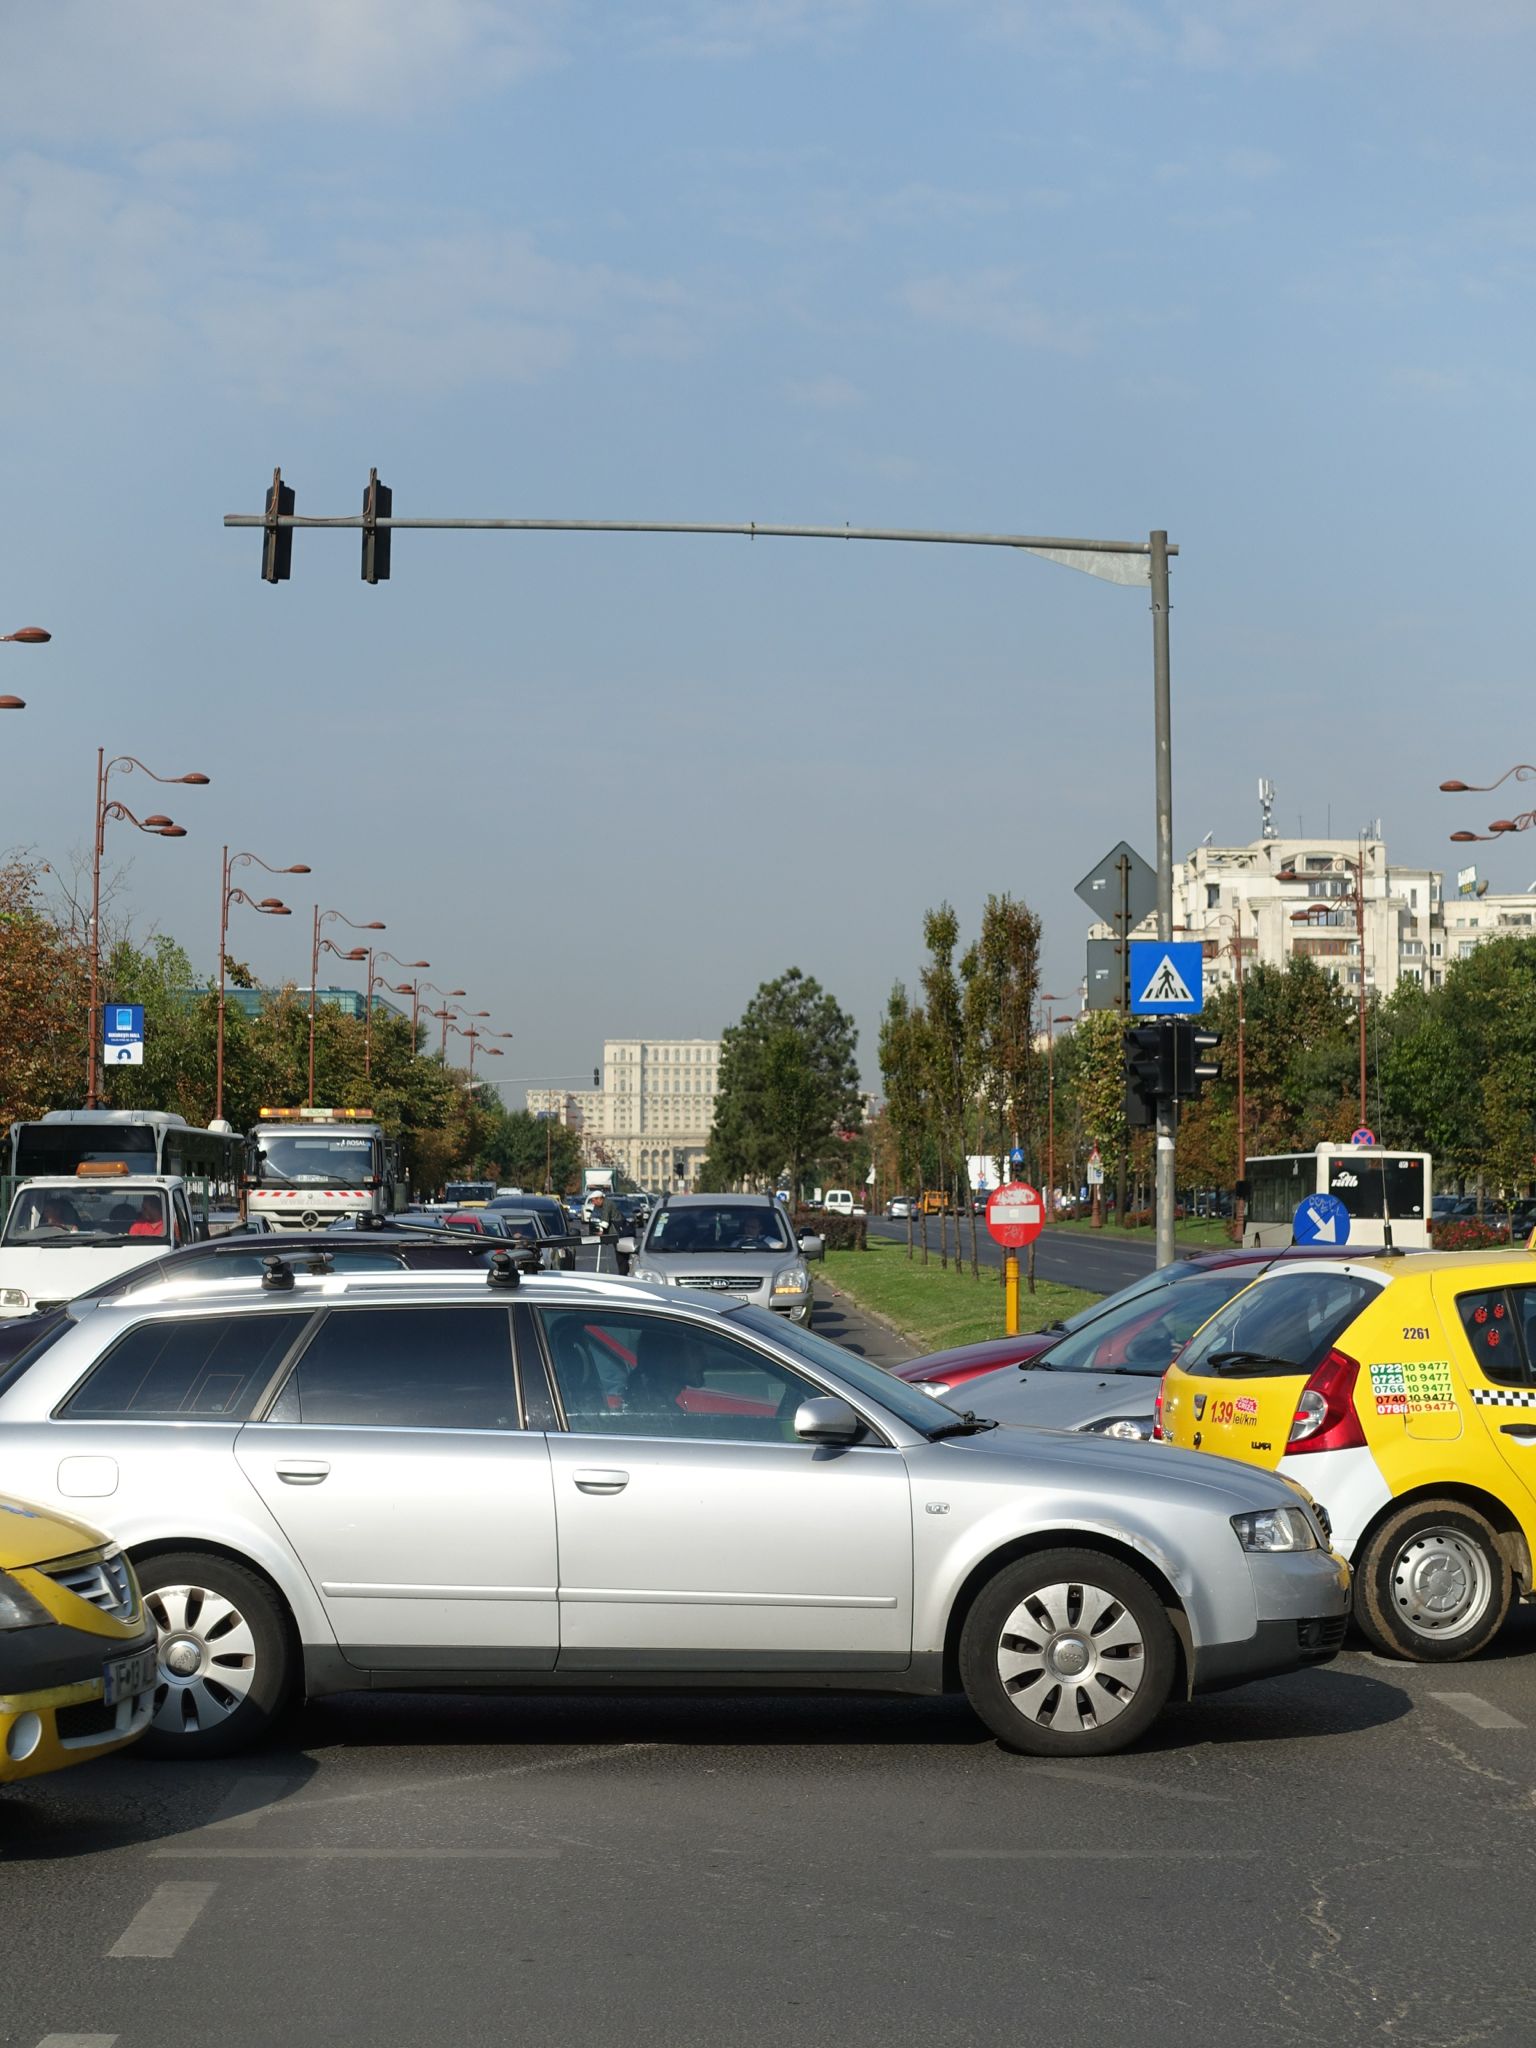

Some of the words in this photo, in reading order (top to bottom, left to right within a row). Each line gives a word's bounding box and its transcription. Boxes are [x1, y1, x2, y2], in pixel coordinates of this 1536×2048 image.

[1403, 1328, 1429, 1339] 2261
[1370, 1364, 1402, 1373] 0722
[1419, 1362, 1448, 1370] 9477
[1372, 1375, 1404, 1384] 0723
[1406, 1374, 1417, 1382] 10
[1420, 1373, 1449, 1381] 9477
[1374, 1385, 1404, 1393] 0766
[1422, 1384, 1451, 1392] 9477
[1376, 1395, 1406, 1404] 0740
[1409, 1394, 1420, 1402] 10
[1423, 1393, 1452, 1402] 9477
[1212, 1401, 1233, 1423] 1.39
[1233, 1414, 1257, 1426] lei/km
[1377, 1404, 1407, 1413] 0788
[1411, 1404, 1422, 1412] 10
[1425, 1403, 1454, 1411] 9477
